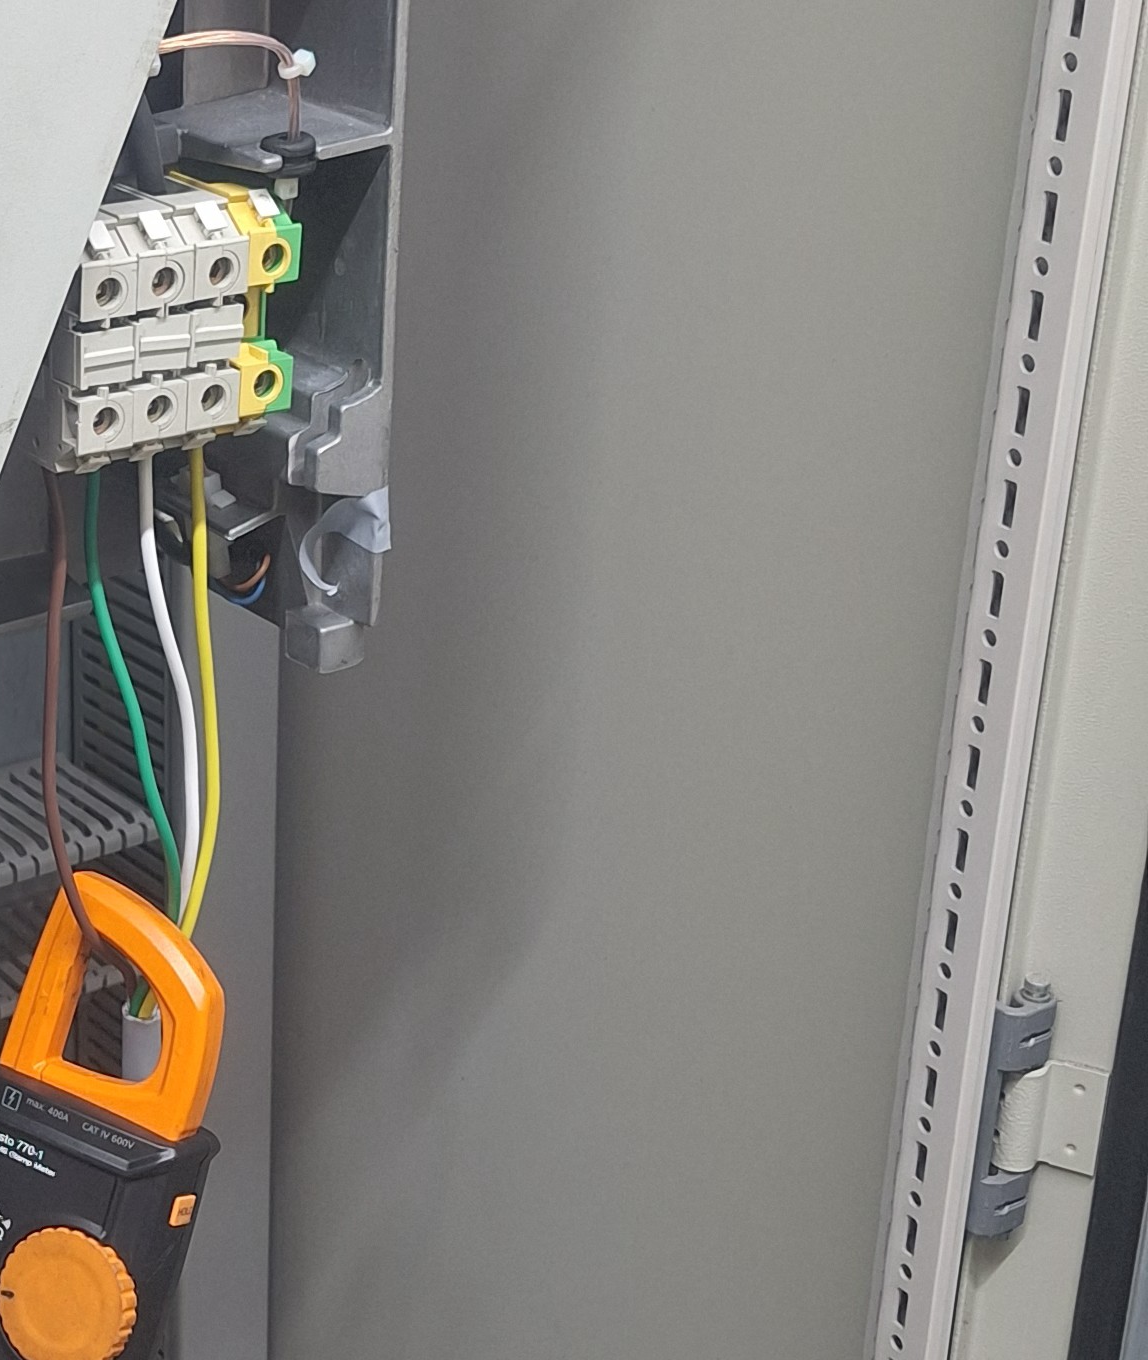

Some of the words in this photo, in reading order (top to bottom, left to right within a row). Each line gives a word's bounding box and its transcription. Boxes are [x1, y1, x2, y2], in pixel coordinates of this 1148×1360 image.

[47, 1106, 69, 1122] 400A
[81, 1121, 99, 1134] CAT
[99, 1128, 110, 1140] IV
[110, 1134, 136, 1150] 600V
[15, 1139, 45, 1160] 770-1
